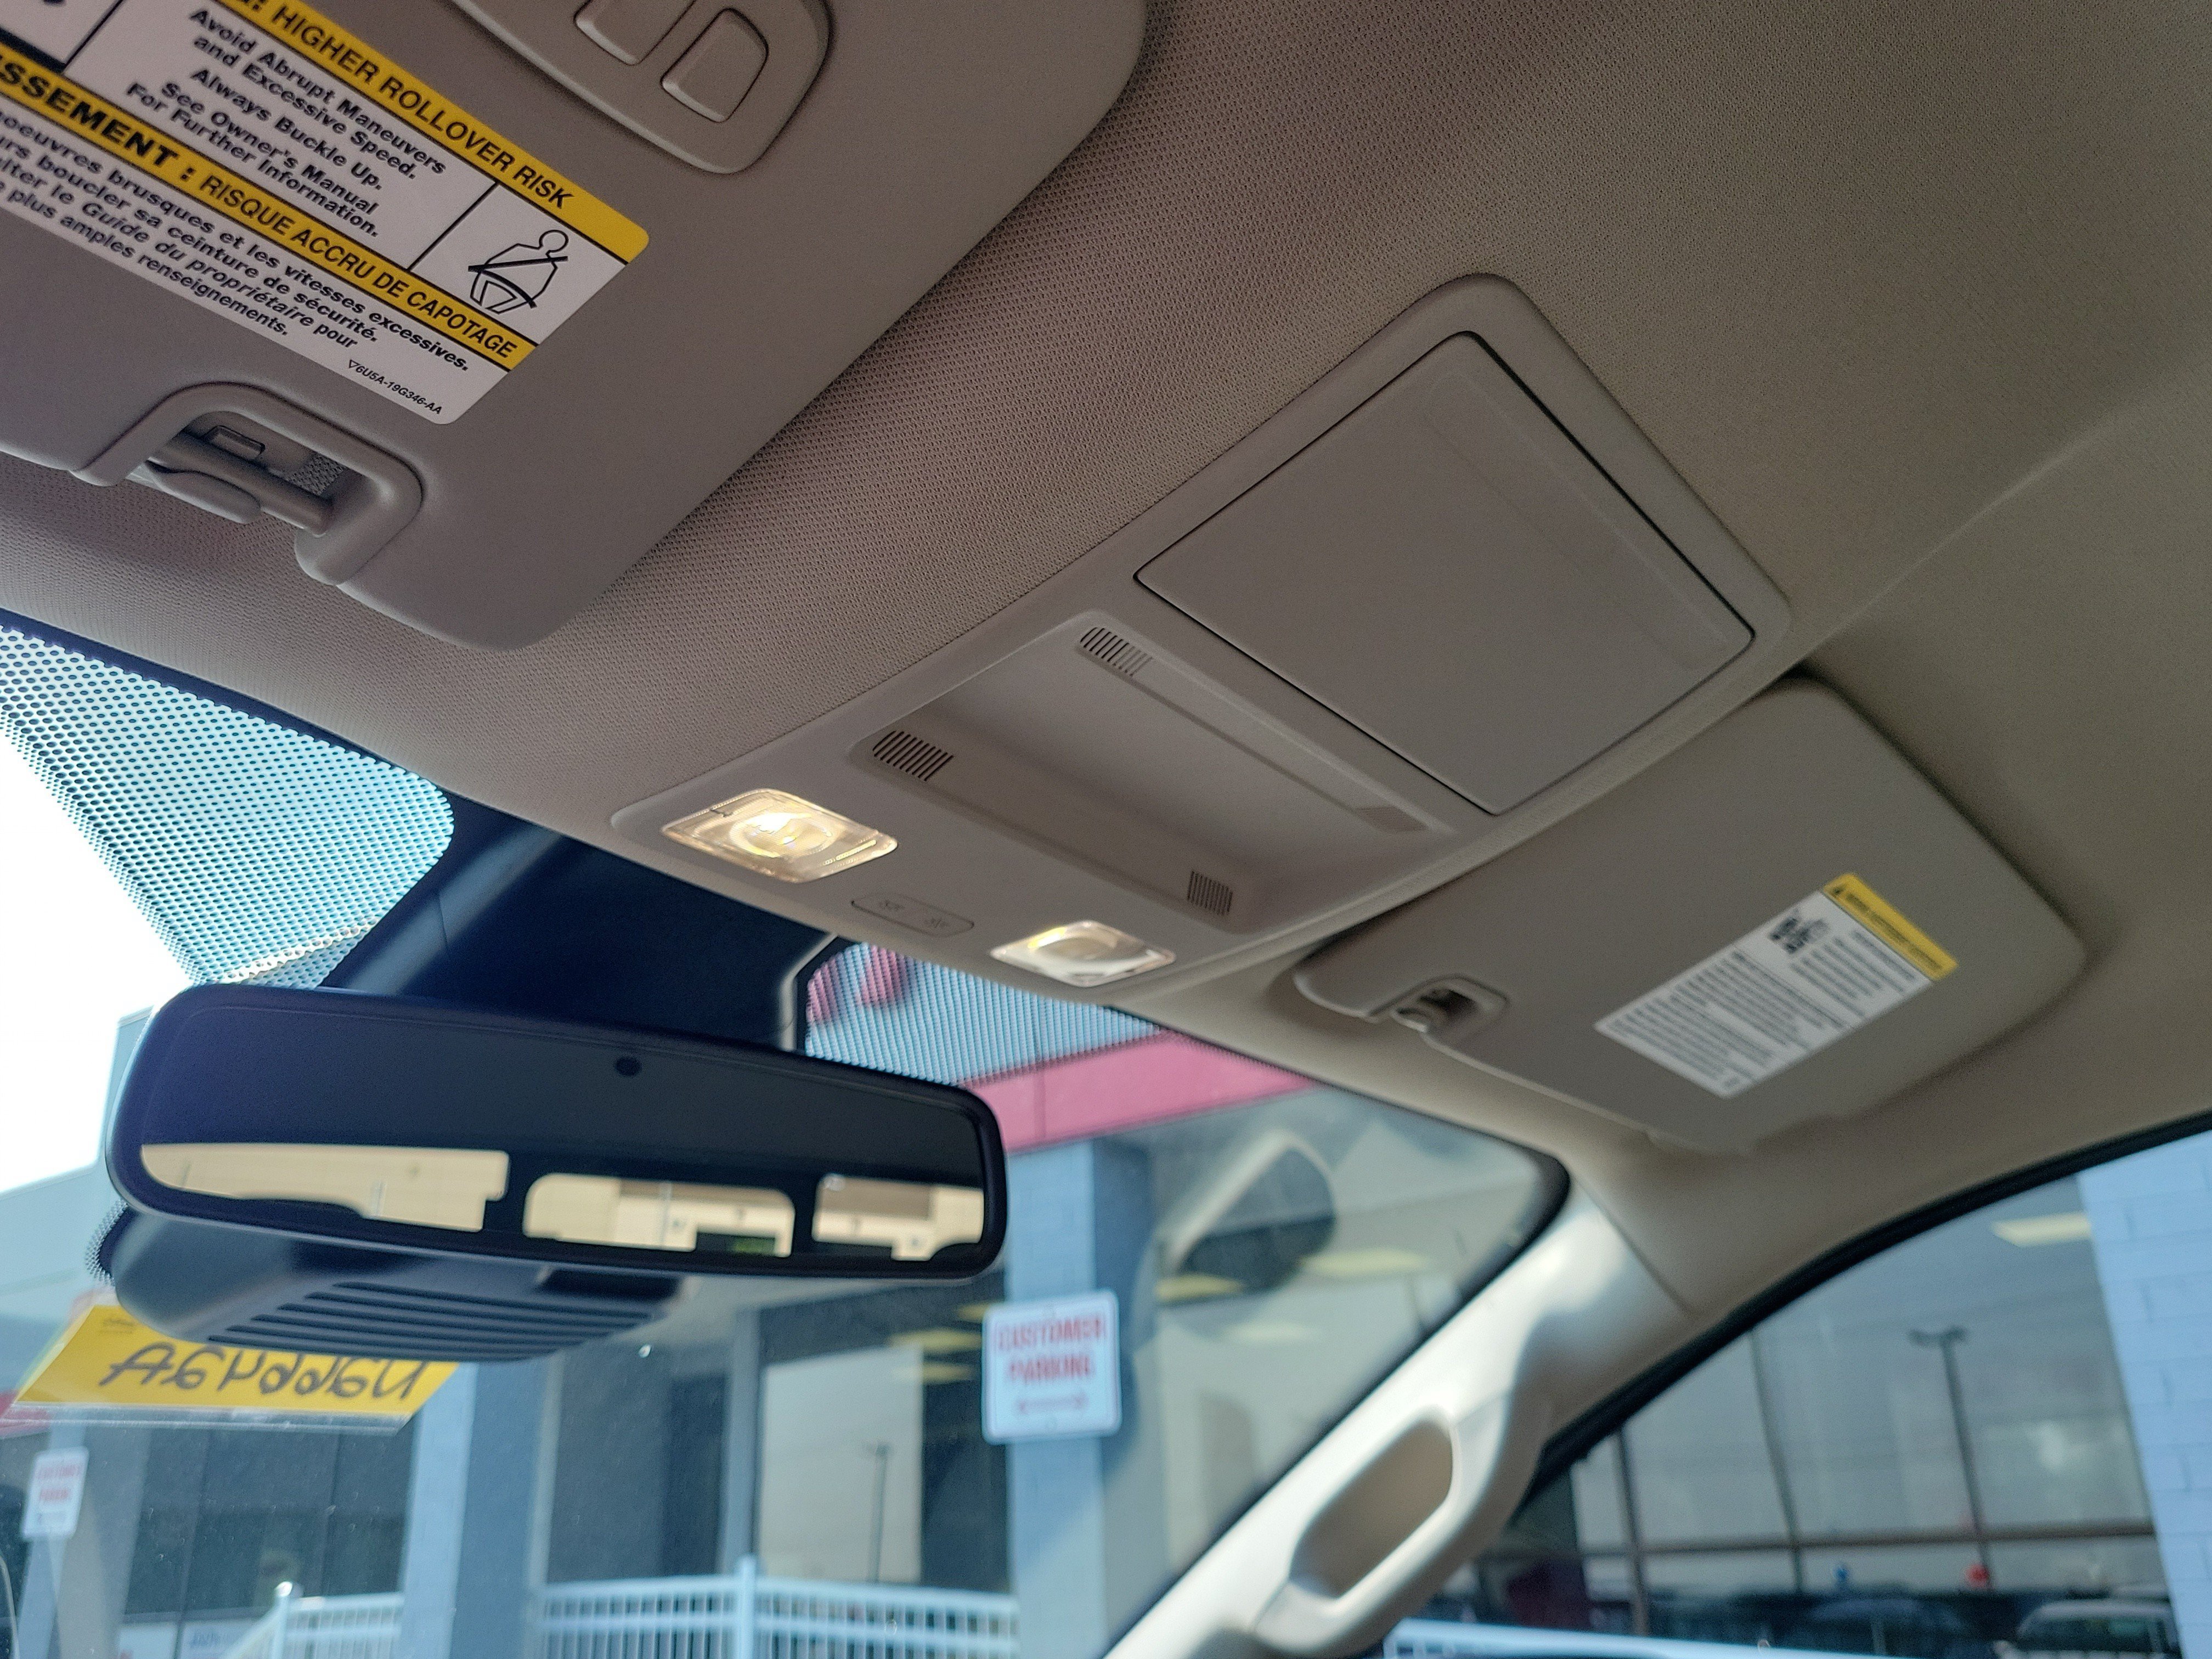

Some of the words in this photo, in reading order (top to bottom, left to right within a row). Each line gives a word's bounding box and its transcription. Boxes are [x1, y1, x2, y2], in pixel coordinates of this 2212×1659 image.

[127, 83, 168, 111] For
[170, 109, 257, 162] Further
[257, 159, 378, 237] Information.
[162, 83, 205, 115] See
[211, 111, 298, 169] Owner's
[301, 164, 379, 215] Manual
[190, 10, 257, 53] Avoid
[257, 52, 335, 104] Abrupt
[336, 99, 446, 174] Maneuvers
[190, 69, 272, 121] Always
[274, 116, 347, 167] Buckle
[351, 161, 382, 190] Up.
[193, 37, 241, 67] and
[242, 63, 347, 134] Excessive
[350, 131, 416, 179] Speed.
[272, 5, 380, 84] HIGHER
[379, 76, 516, 173] ROLLOVER
[512, 165, 574, 210] RISK
[0, 59, 179, 167] SSEMENT
[199, 174, 295, 236] RISQUE
[291, 229, 376, 279] ACCRU
[373, 271, 410, 298] DE
[407, 291, 517, 358] CAPOTAGE
[0, 158, 47, 189] lter
[50, 184, 75, 205] le
[82, 202, 150, 243] Guide
[155, 242, 187, 262] du
[185, 259, 315, 326] propriétaire
[313, 323, 358, 348] pour
[7, 189, 57, 219] plus
[60, 216, 136, 258] amples
[137, 254, 288, 336] renseignements.
[37, 154, 131, 209] boucler
[134, 209, 163, 228] sa
[167, 227, 259, 278] ceinture
[263, 276, 290, 295] de
[294, 292, 378, 342] sécurité.
[108, 168, 215, 233] brusques
[219, 232, 245, 250] et
[247, 244, 280, 268] les
[285, 265, 366, 315] vitesses
[369, 313, 468, 371] excessives.
